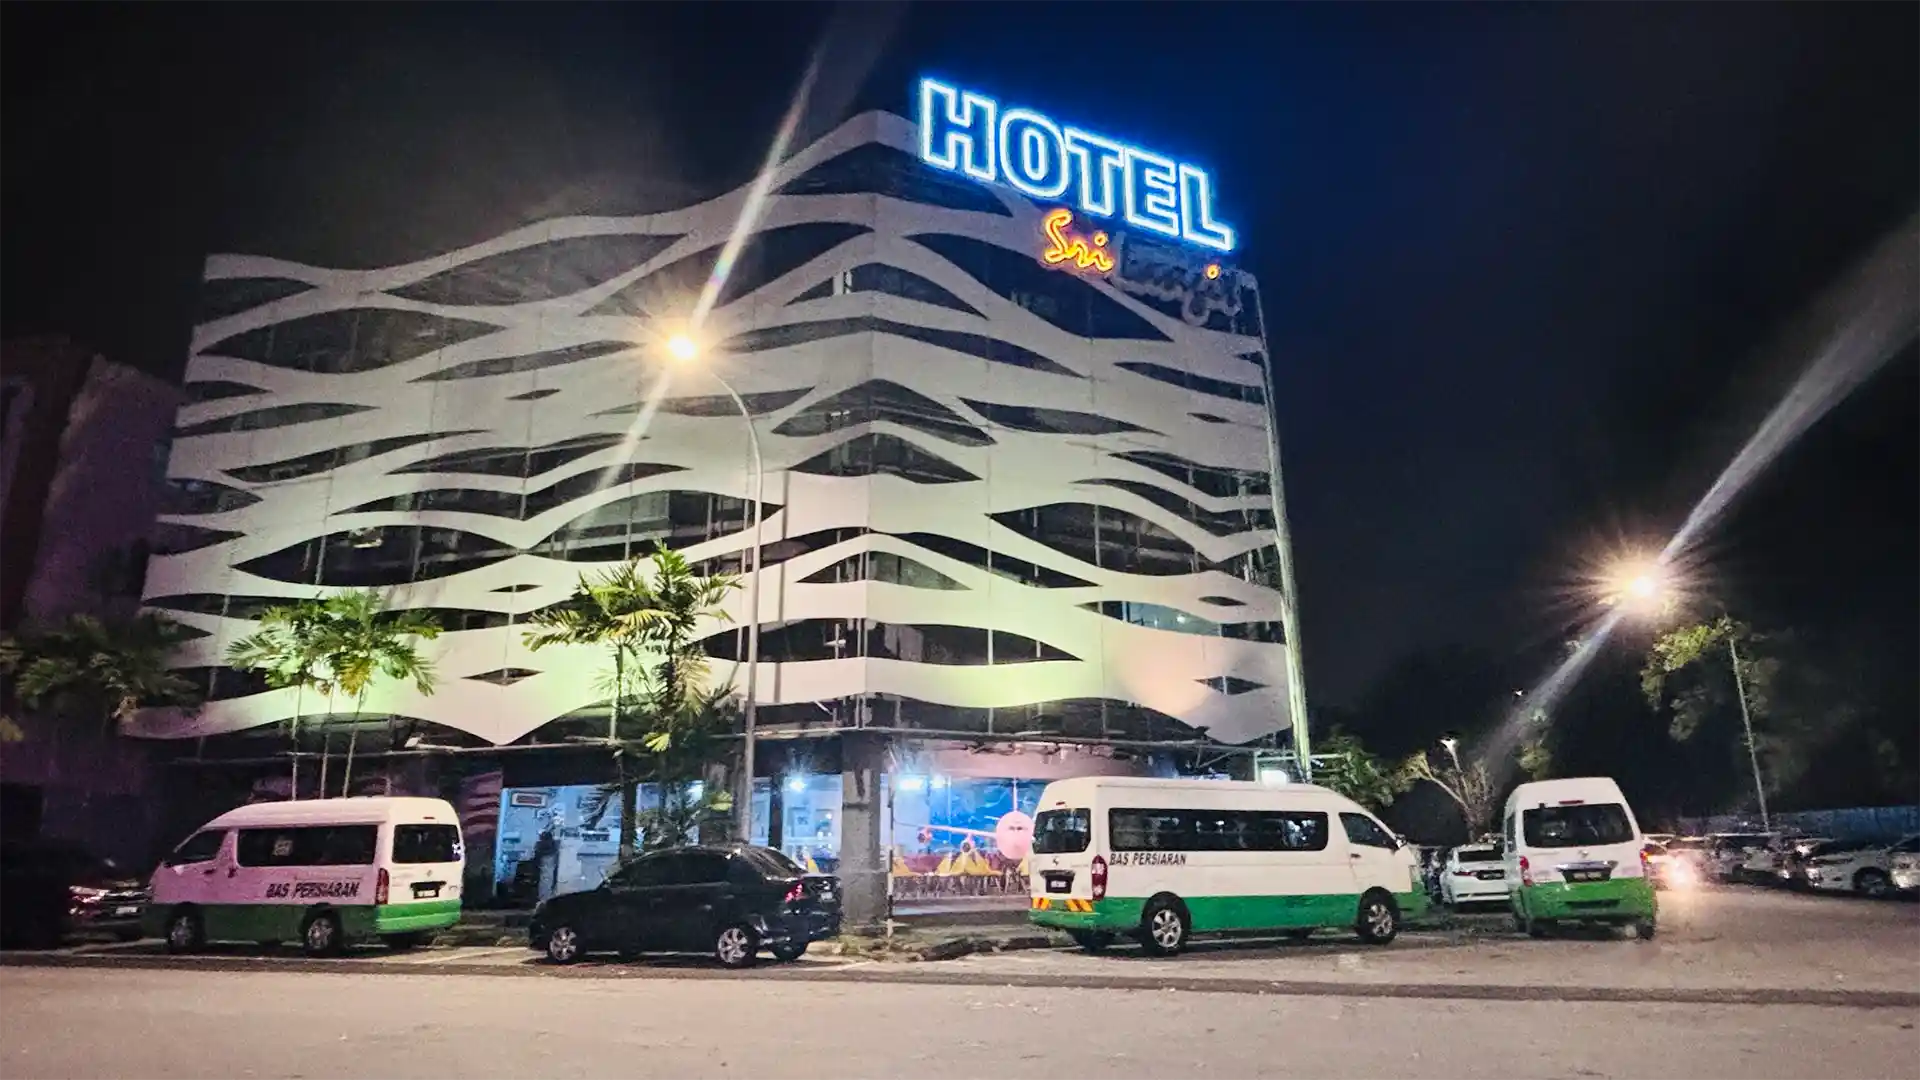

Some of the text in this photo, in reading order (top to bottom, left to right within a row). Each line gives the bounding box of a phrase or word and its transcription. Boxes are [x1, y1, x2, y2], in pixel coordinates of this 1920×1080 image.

[919, 77, 1235, 252] HOTEL
[1044, 208, 1114, 272] Sri
[1109, 852, 1187, 866] BAS PERSIARAN
[266, 881, 360, 899] BAS PERSIARAN
